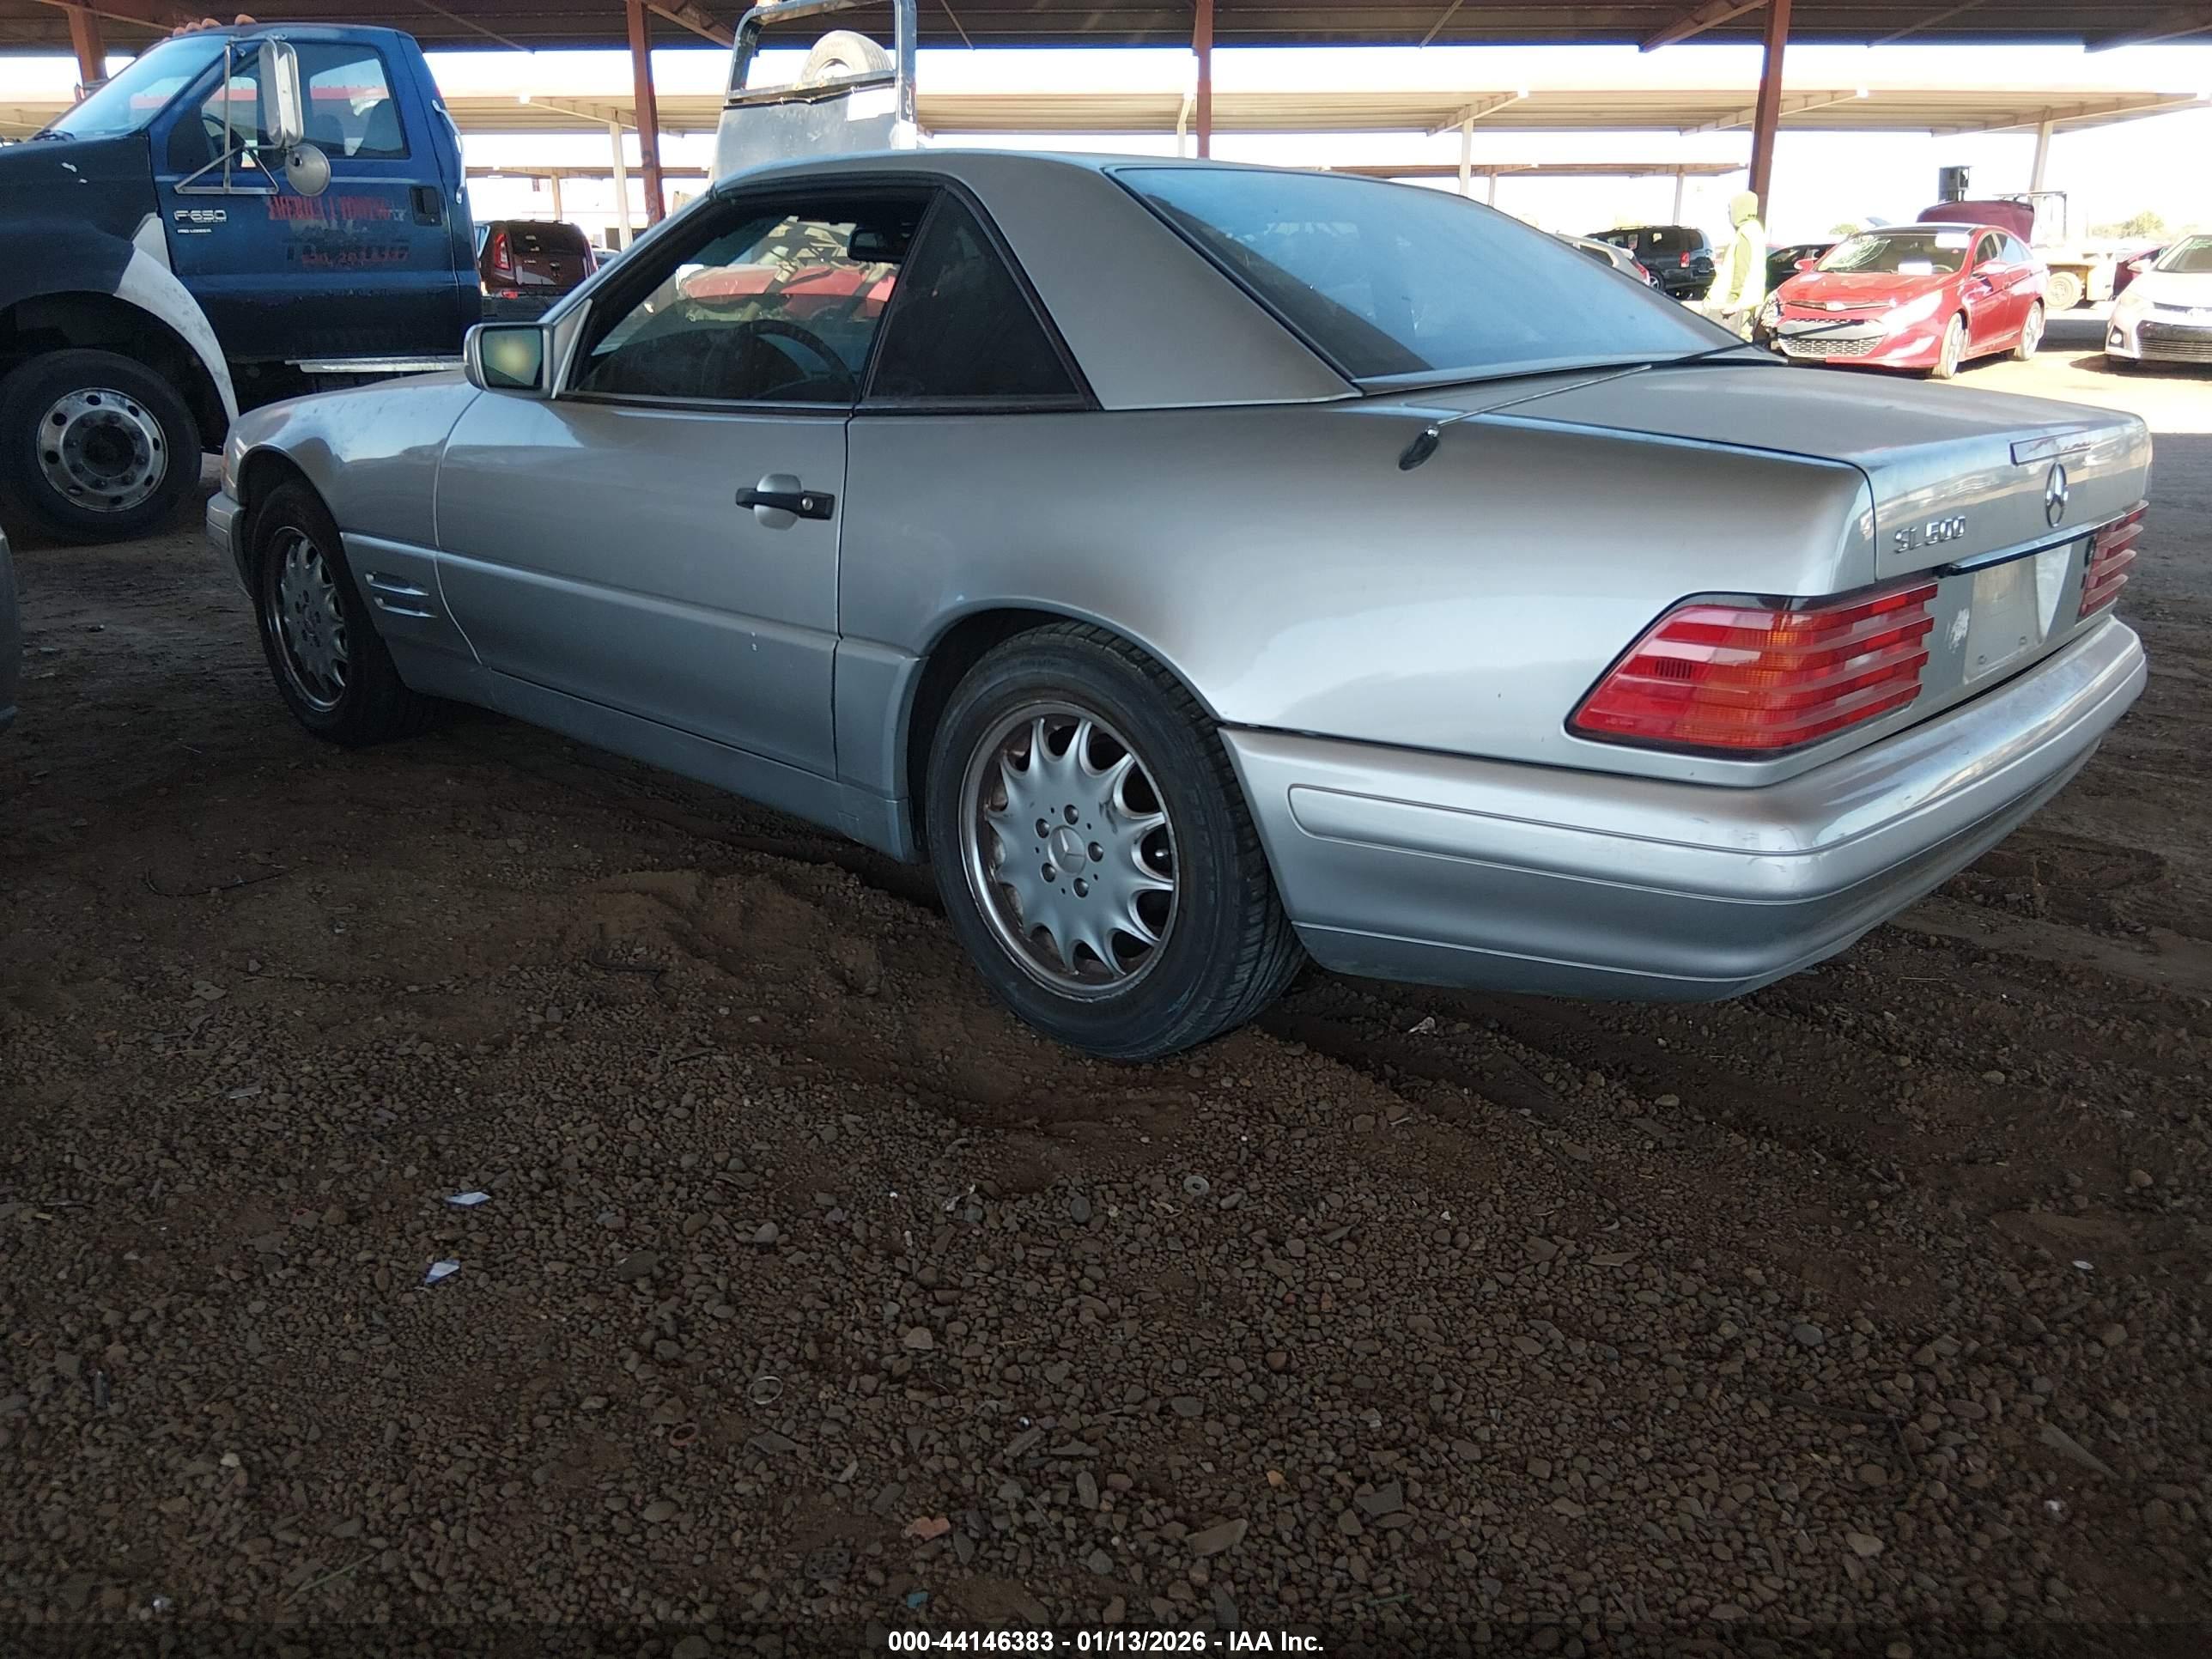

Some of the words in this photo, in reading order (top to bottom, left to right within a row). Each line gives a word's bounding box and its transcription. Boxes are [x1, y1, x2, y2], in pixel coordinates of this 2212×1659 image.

[174, 210, 228, 222] F-650
[1894, 526, 1923, 553] SL
[1925, 516, 1966, 545] 500
